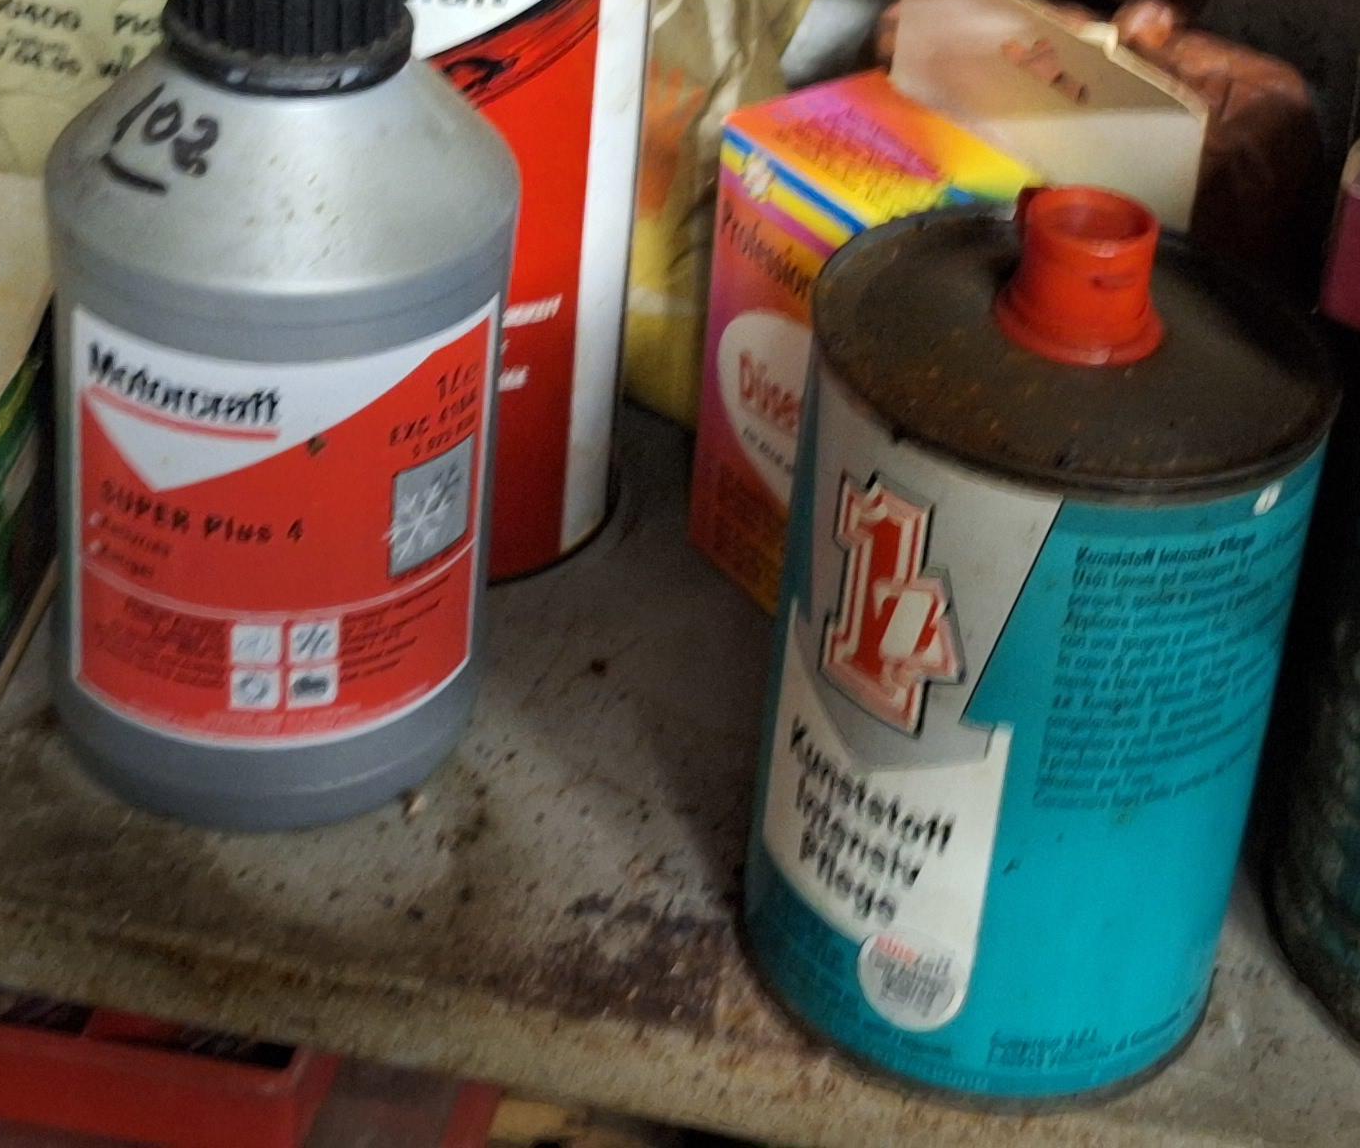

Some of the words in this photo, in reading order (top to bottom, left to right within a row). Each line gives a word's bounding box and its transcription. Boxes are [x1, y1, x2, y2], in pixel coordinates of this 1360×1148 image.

[100, 478, 191, 536] SUPER
[202, 513, 274, 544] Plus
[285, 515, 305, 544] 4
[790, 714, 957, 857] Kunststoff
[798, 828, 897, 928] Pflege
